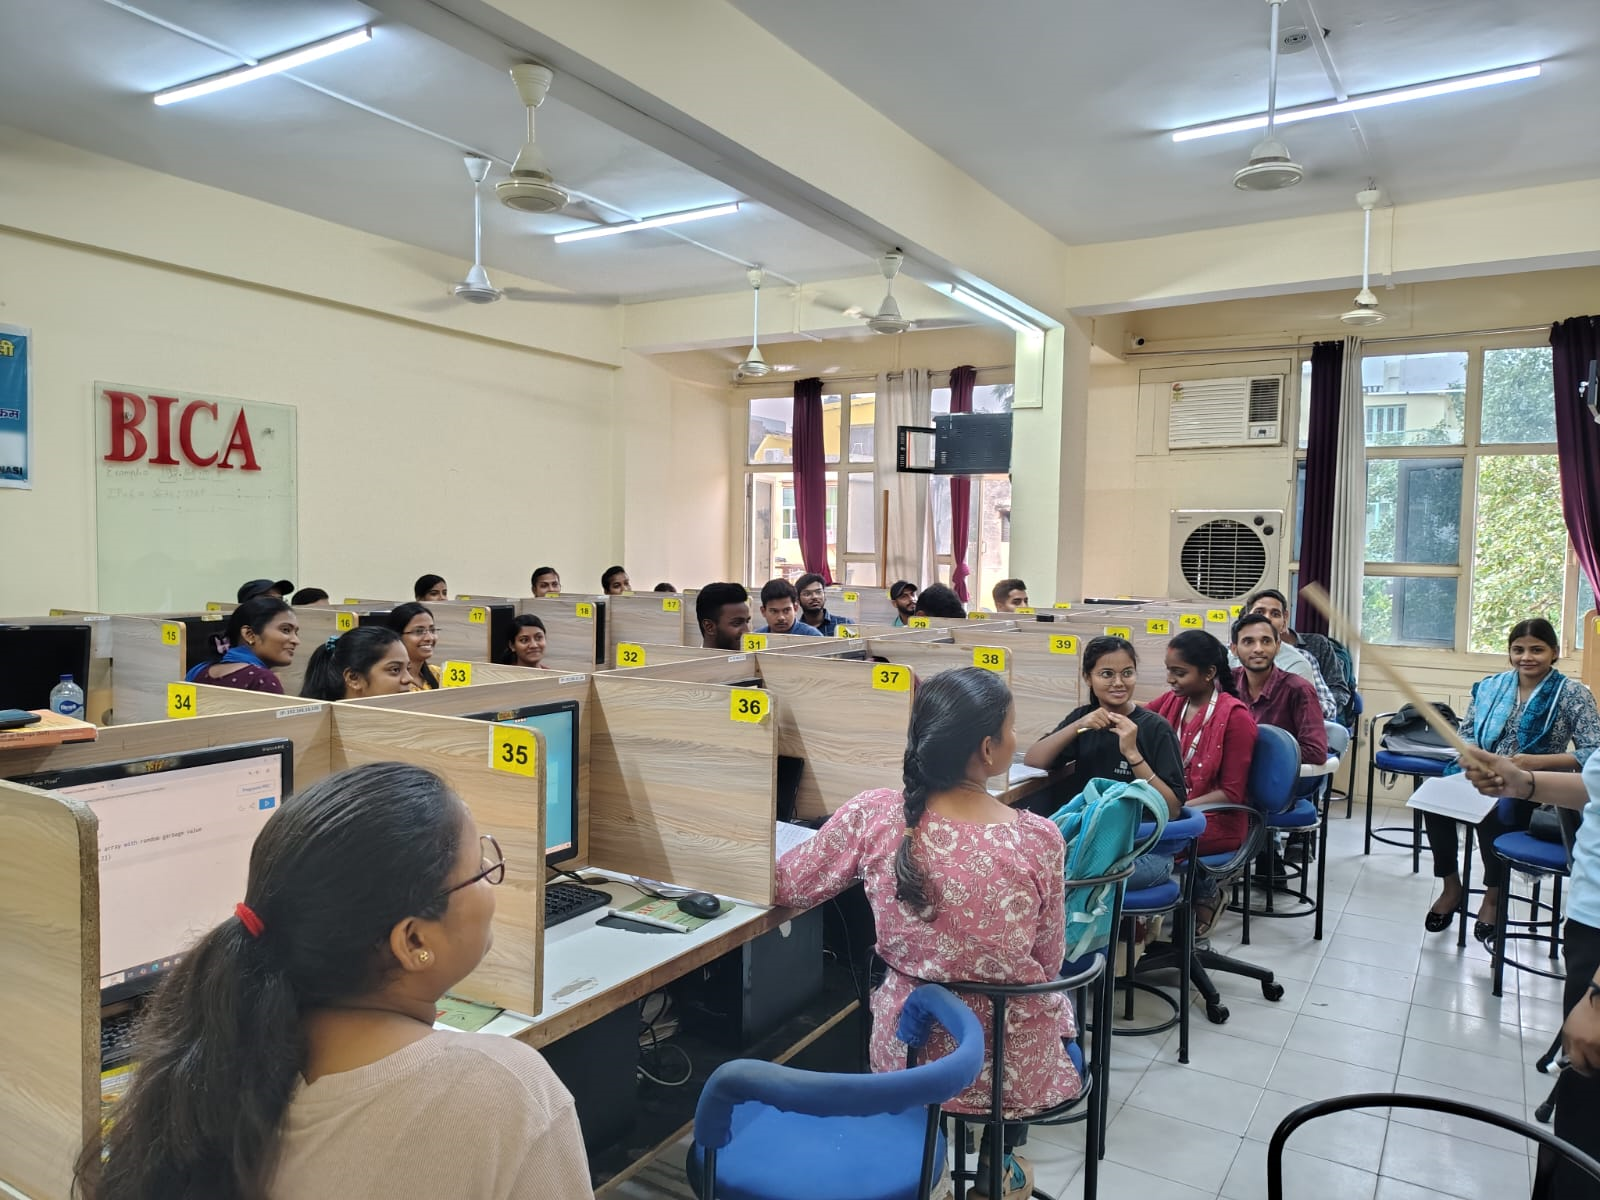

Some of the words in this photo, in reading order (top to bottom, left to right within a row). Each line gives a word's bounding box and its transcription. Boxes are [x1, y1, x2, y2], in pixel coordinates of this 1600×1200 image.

[103, 389, 262, 471] BICA
[473, 612, 482, 620] 17
[1184, 617, 1197, 625] 42
[341, 619, 351, 628] 16
[1151, 623, 1164, 631] 41
[166, 631, 176, 641] 15
[748, 640, 761, 650] 31
[1055, 639, 1072, 650] 39
[623, 651, 638, 663] 32
[982, 653, 999, 665] 38
[450, 668, 466, 682] 33
[880, 670, 899, 684] 37
[174, 693, 192, 711] 34
[738, 697, 761, 715] 36
[501, 742, 529, 765] 35
